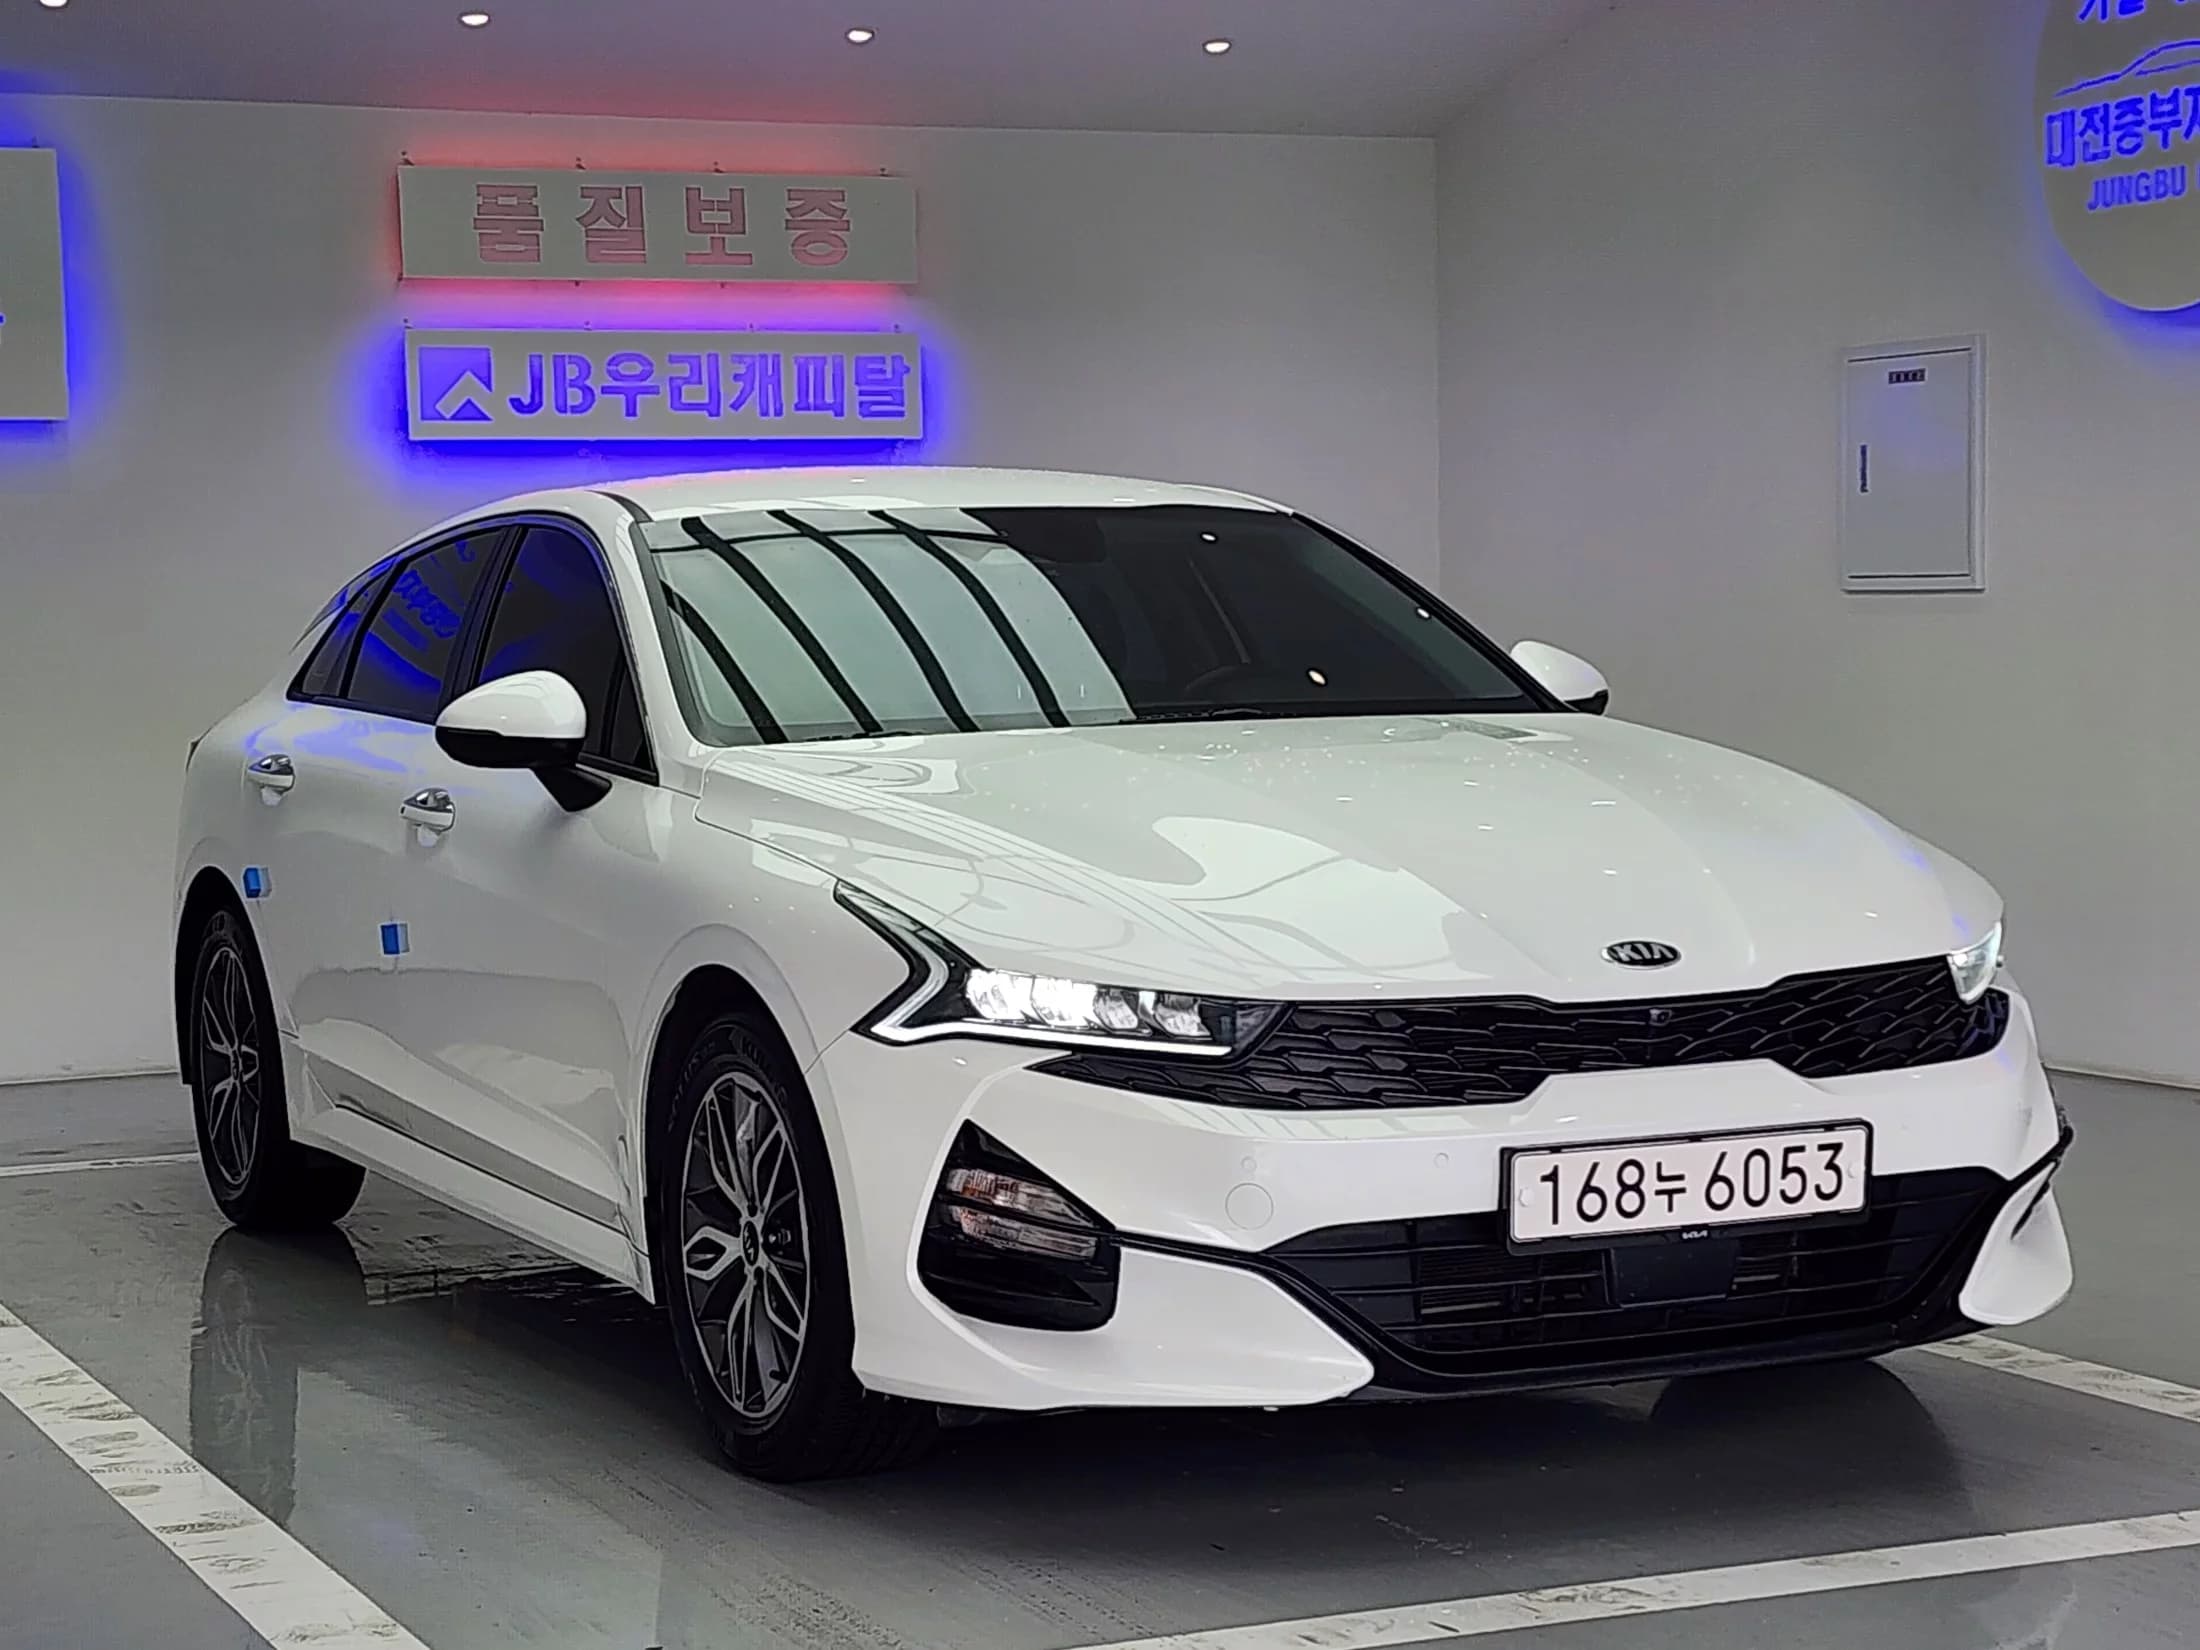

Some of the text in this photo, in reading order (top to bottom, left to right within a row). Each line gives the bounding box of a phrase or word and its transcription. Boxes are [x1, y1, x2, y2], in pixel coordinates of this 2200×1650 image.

[2087, 166, 2186, 210] JUNGBU
[473, 183, 852, 267] 품질보증
[509, 352, 911, 419] JB우리캐피탈
[1612, 943, 1675, 963] KIA
[1539, 1141, 1845, 1226] 168누 6053
